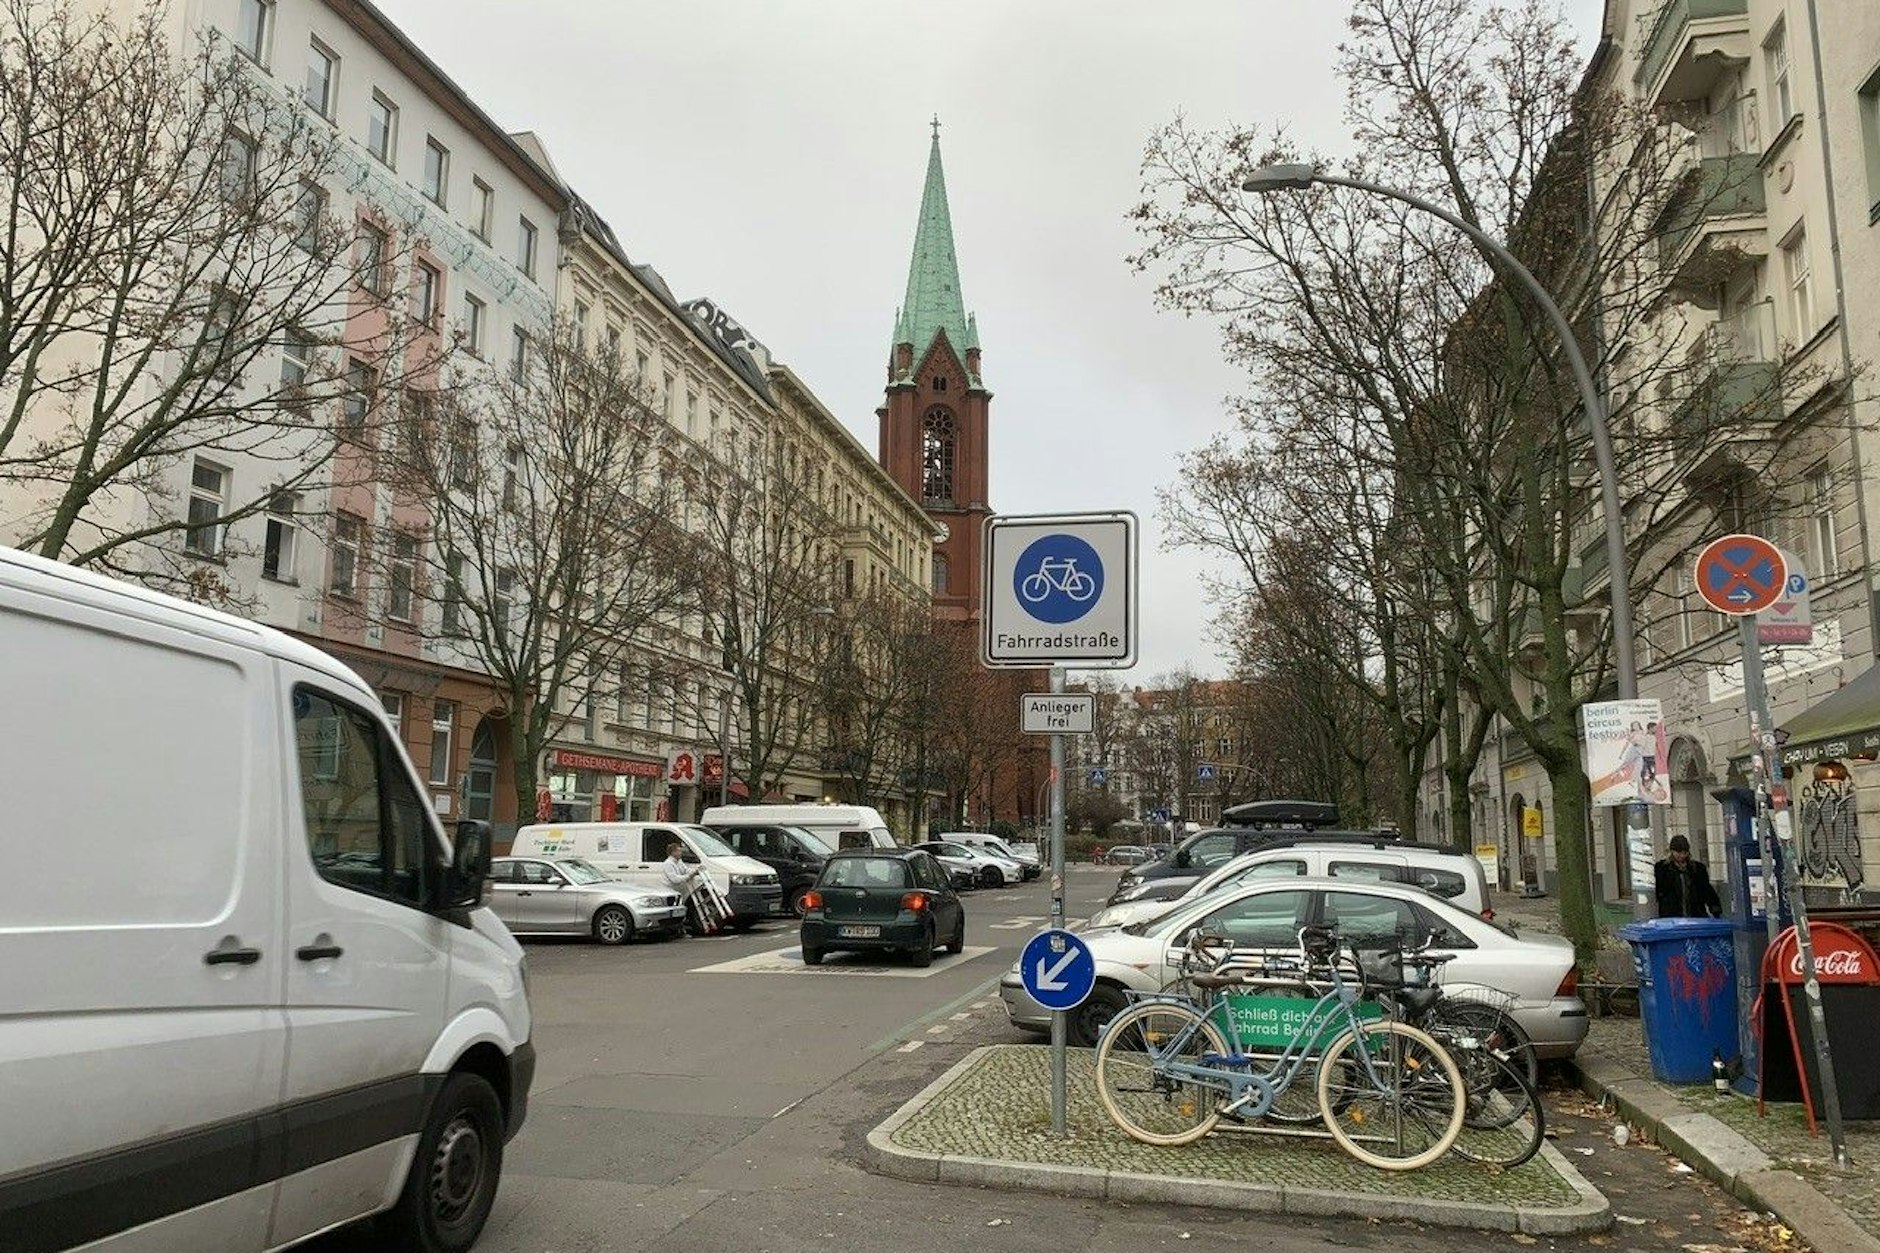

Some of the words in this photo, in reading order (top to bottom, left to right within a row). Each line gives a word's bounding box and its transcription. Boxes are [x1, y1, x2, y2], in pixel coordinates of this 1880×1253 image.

[998, 632, 1119, 648] Fahrradstraße
[1030, 702, 1085, 715] Anlieger
[1587, 706, 1619, 717] berlin
[1047, 715, 1069, 727] frei
[1587, 719, 1622, 729] circus
[1790, 950, 1862, 975] Ca-Cola
[1228, 1021, 1279, 1035] ahrrad
